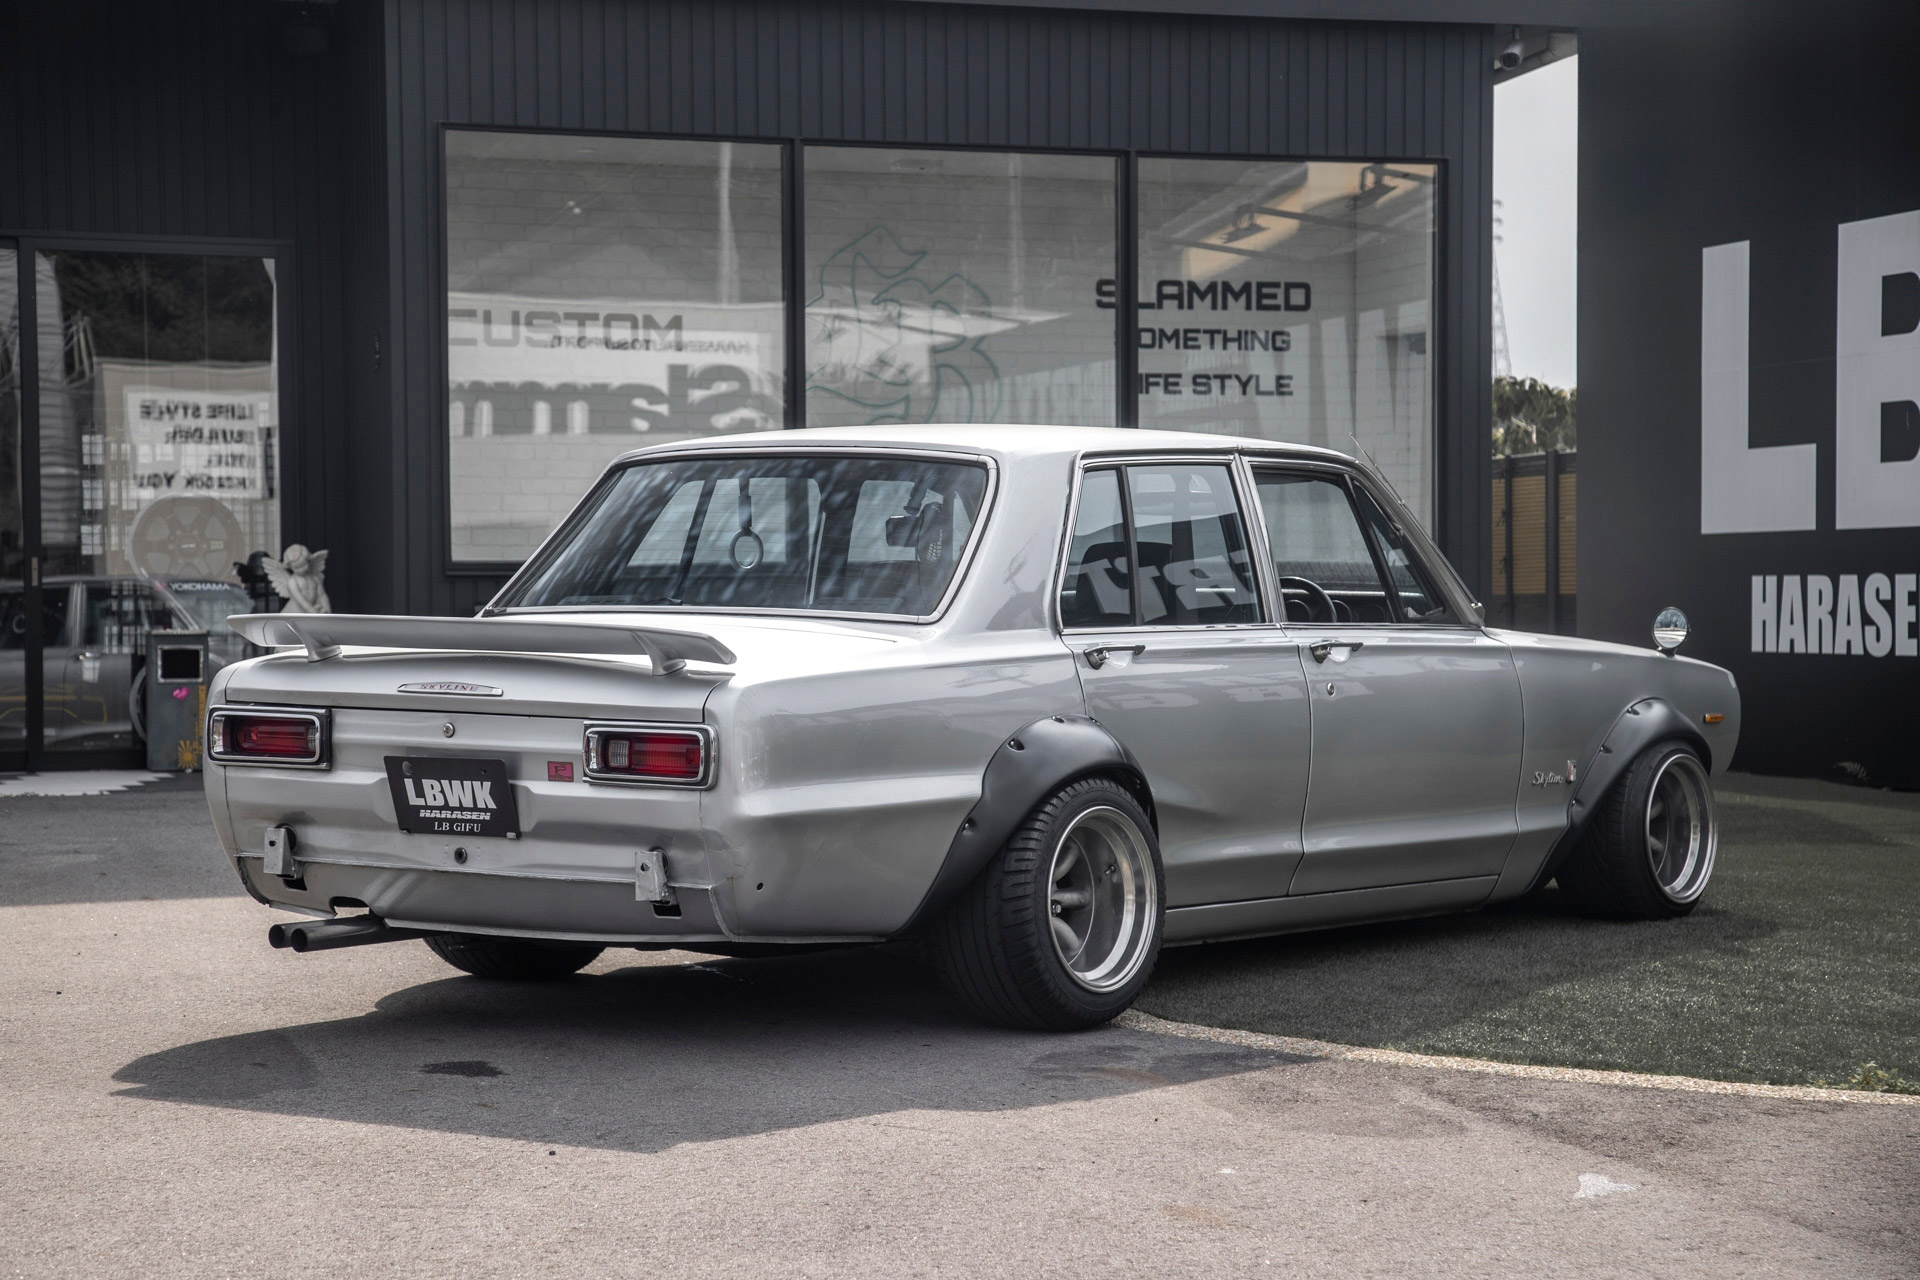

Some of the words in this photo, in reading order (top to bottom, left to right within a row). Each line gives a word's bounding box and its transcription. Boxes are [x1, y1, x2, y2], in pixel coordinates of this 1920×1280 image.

[448, 308, 684, 352] CUSTOM
[1115, 327, 1292, 352] OMETHING
[1701, 210, 1920, 534] LB
[1138, 373, 1182, 395] IFE
[1192, 373, 1294, 396] STYLE
[170, 582, 230, 592] YOKOHAMA
[1751, 572, 1920, 657] HARASE
[420, 683, 477, 692] SKYLINE
[1532, 771, 1563, 787] Skyline
[404, 778, 497, 809] LBWK
[419, 809, 491, 821] HARASEN
[434, 821, 450, 831] LB
[453, 822, 482, 833] GIFU
